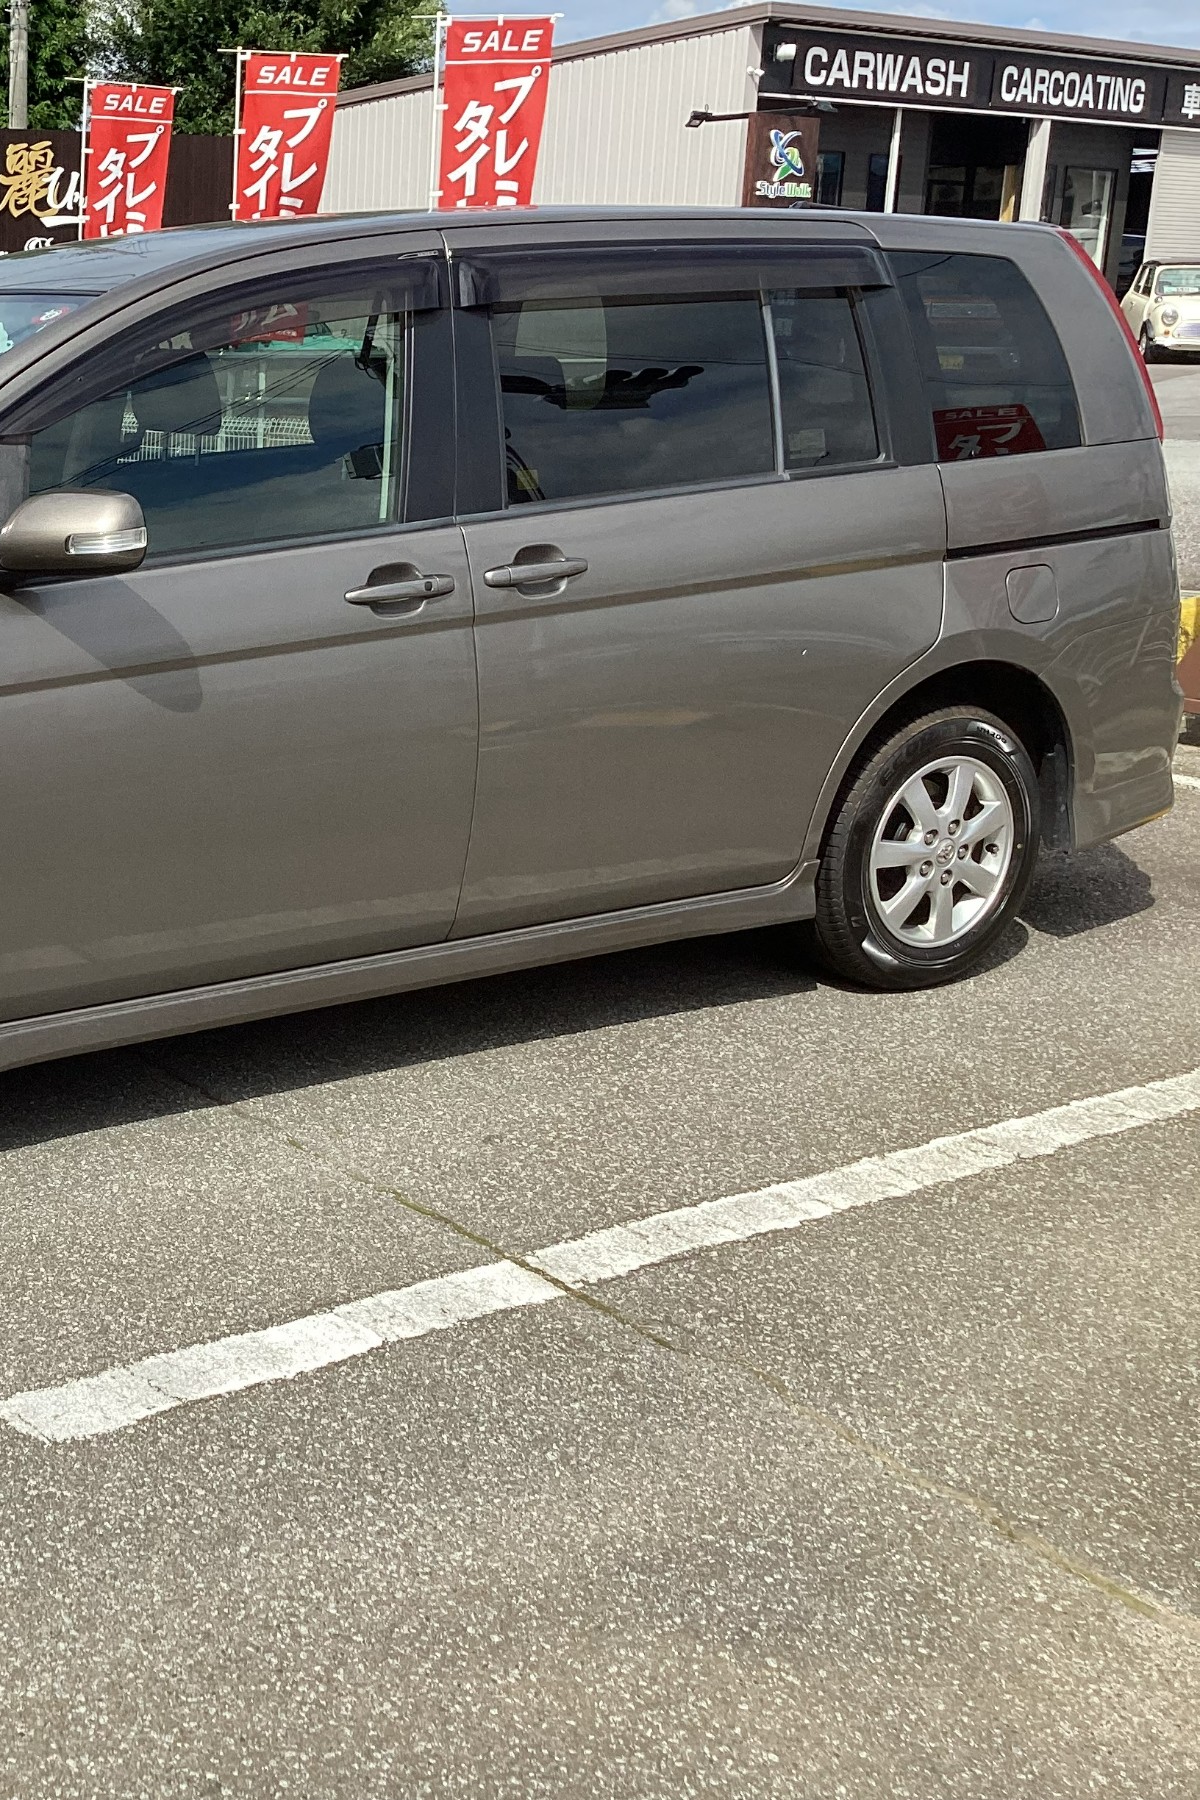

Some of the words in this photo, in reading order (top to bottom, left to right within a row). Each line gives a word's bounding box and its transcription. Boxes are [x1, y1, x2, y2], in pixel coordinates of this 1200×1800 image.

[461, 29, 544, 53] SALE
[256, 65, 331, 86] SALE
[803, 46, 971, 98] CARWASH
[1000, 64, 1146, 114] CARCOATING
[103, 93, 167, 114] SALE
[945, 407, 1018, 420] SALE
